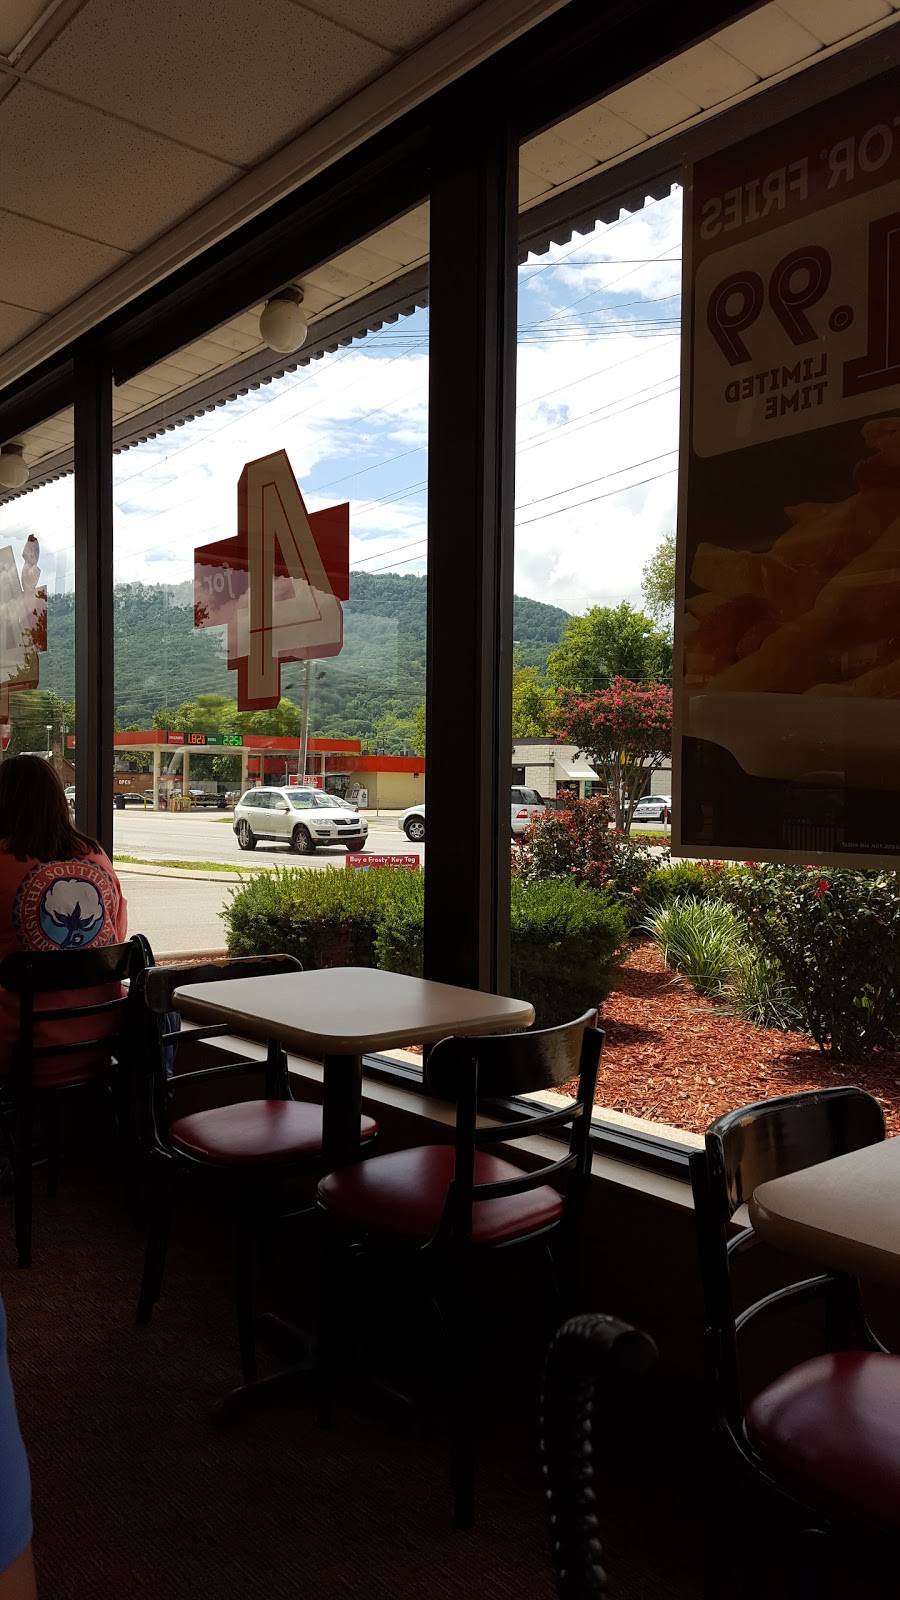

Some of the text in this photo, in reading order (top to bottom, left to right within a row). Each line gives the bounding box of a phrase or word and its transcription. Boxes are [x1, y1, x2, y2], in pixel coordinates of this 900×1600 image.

[391, 856, 403, 864] Key
[404, 856, 416, 864] Tag
[25, 879, 48, 915] THE
